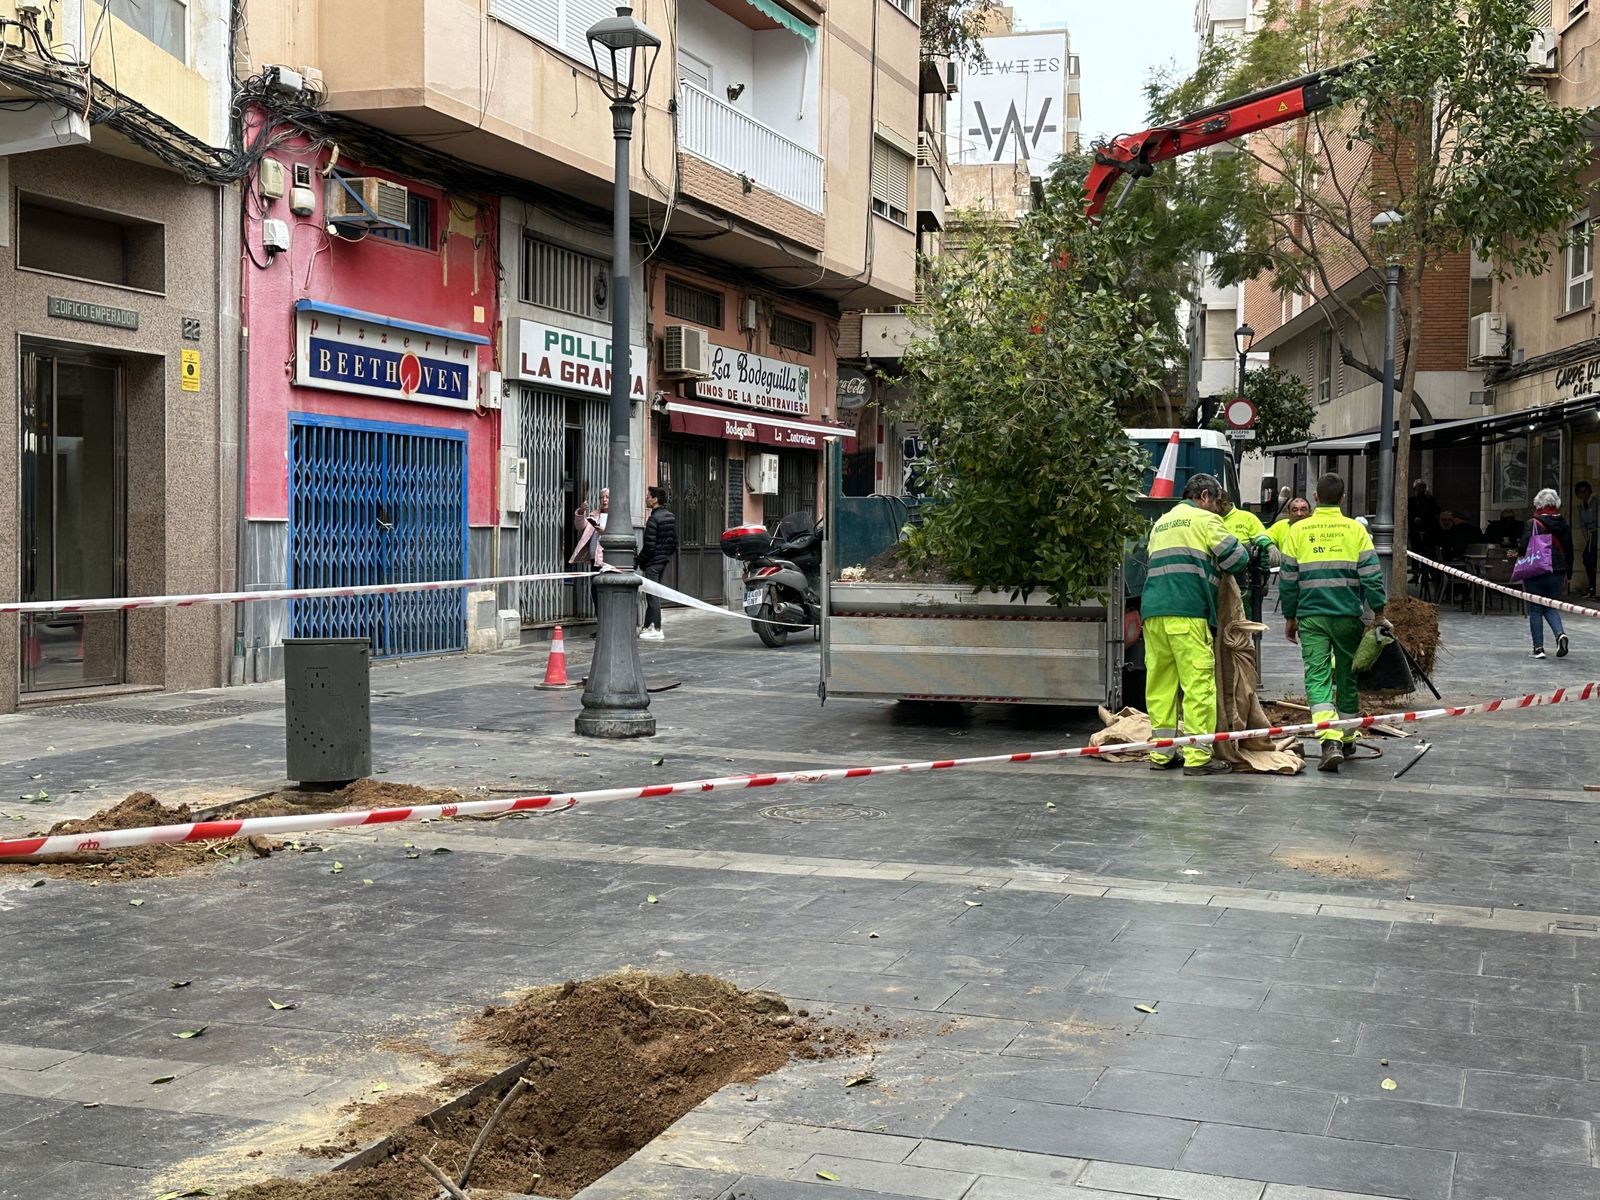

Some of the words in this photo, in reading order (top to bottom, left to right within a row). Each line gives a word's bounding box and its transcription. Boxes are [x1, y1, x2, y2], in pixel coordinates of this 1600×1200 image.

[54, 299, 88, 318] EDIFICIO
[90, 306, 136, 325] EMPERADOR
[184, 318, 200, 339] 22
[310, 318, 469, 360] pizzeria
[319, 348, 462, 398] BEETHOVEN
[521, 352, 552, 378] LA
[711, 348, 731, 380] La
[736, 352, 797, 394] Bodeguilla
[1556, 364, 1585, 390] CARPE
[698, 382, 723, 398] VINOS
[727, 388, 738, 401] DE
[742, 392, 752, 404] LA
[756, 395, 809, 413] CONTRAVIESA
[725, 421, 755, 440] Bodeguilla
[774, 428, 782, 442] La
